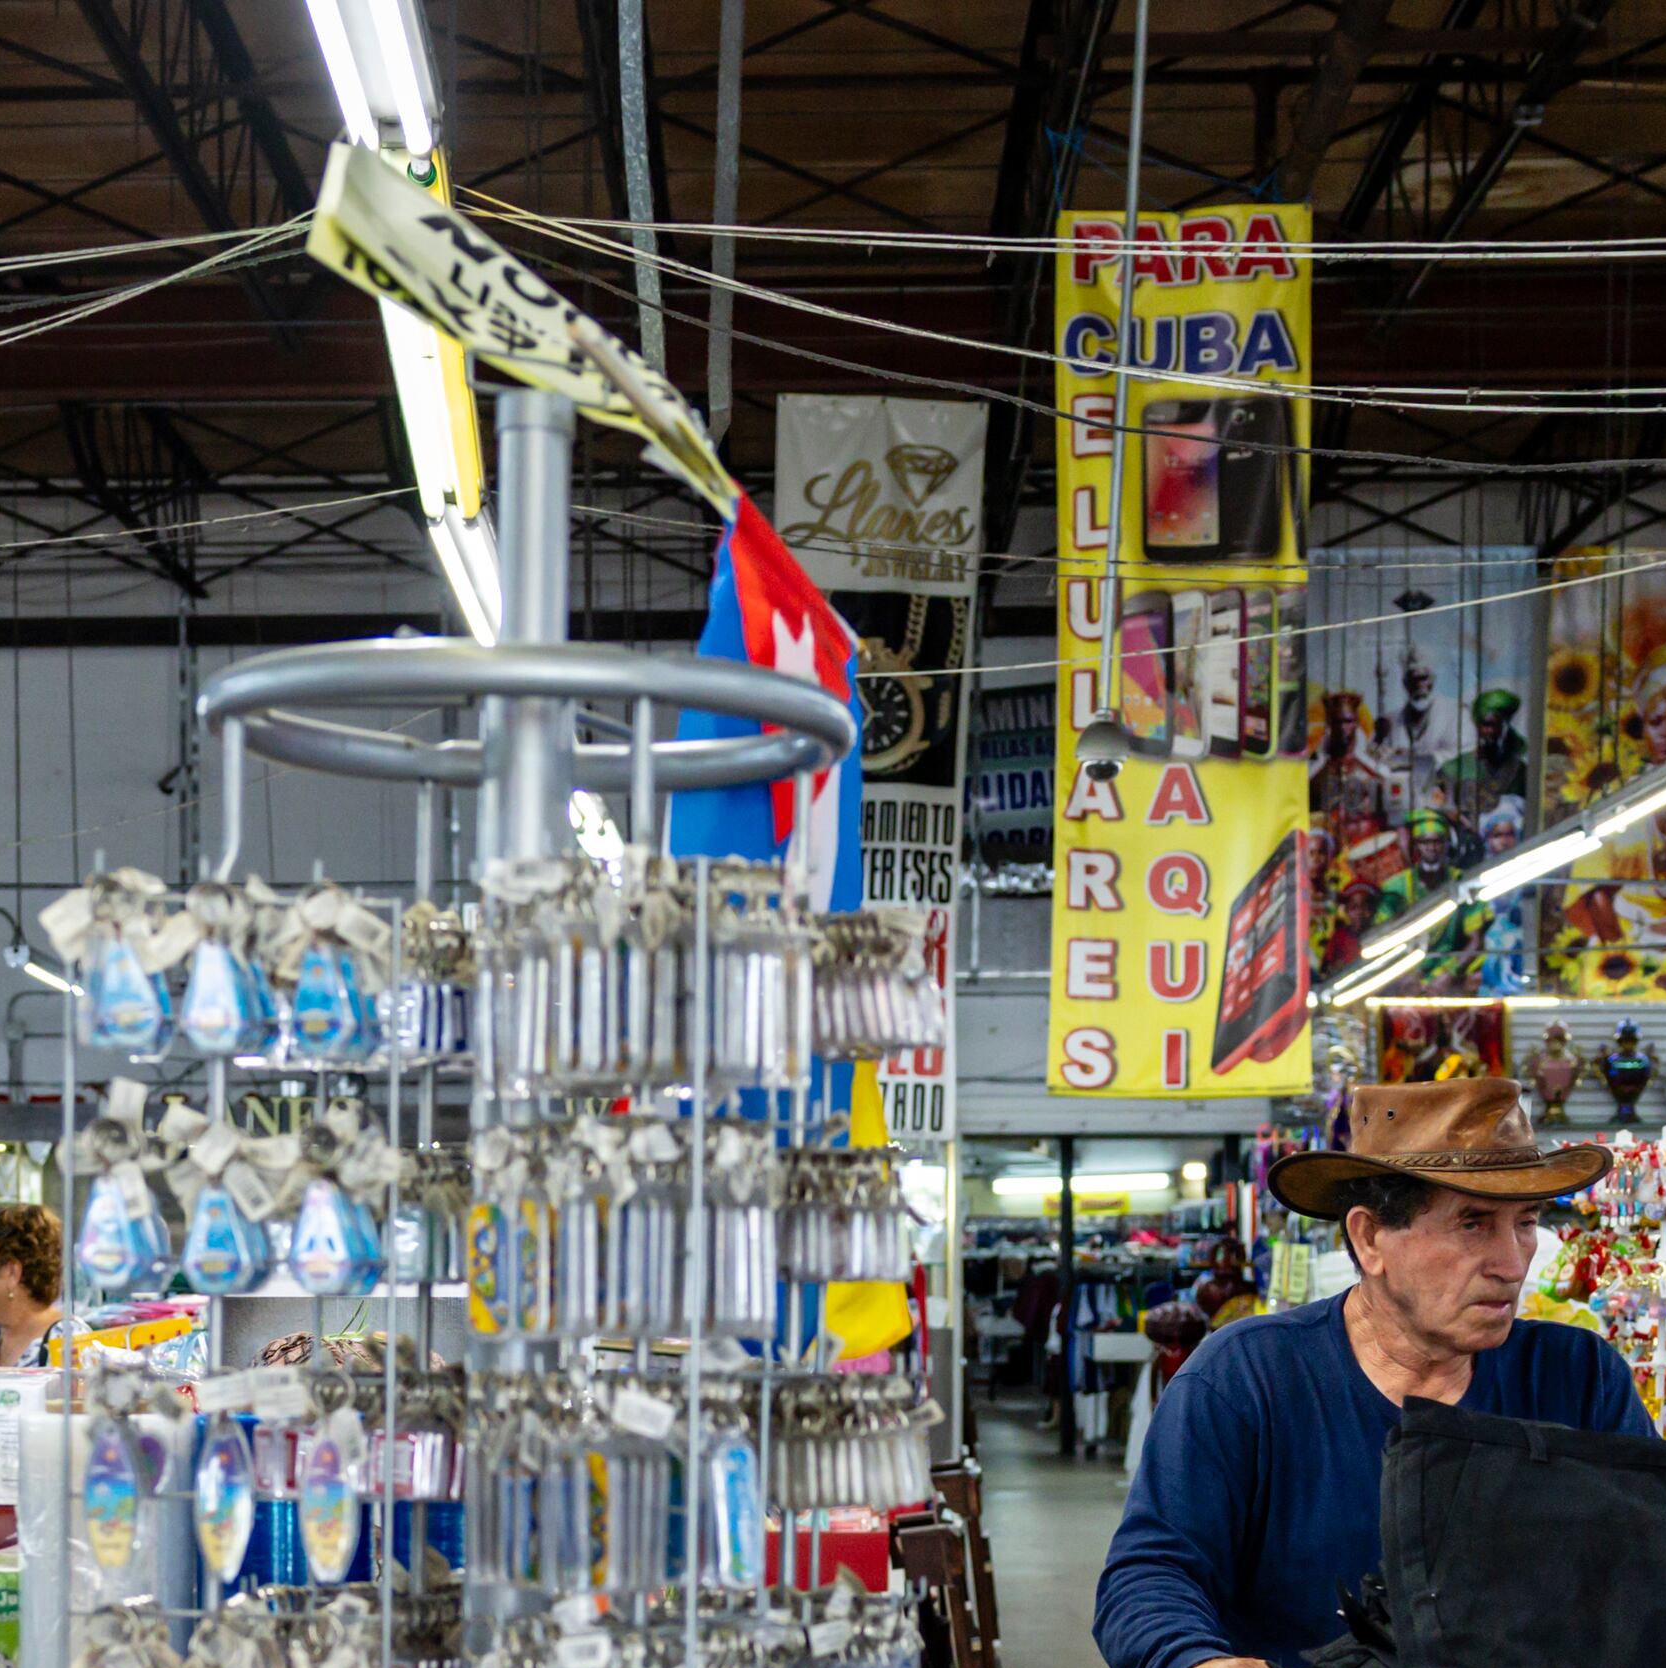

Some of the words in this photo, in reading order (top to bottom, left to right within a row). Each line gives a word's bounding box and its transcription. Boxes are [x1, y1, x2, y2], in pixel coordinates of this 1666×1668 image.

[1071, 213, 1297, 287] PARA
[1061, 309, 1299, 382] CUBA
[782, 458, 976, 549] Llanes
[861, 545, 968, 583] JEWELRY
[861, 798, 955, 847] AMIENTO
[1144, 761, 1211, 1091] AQUI
